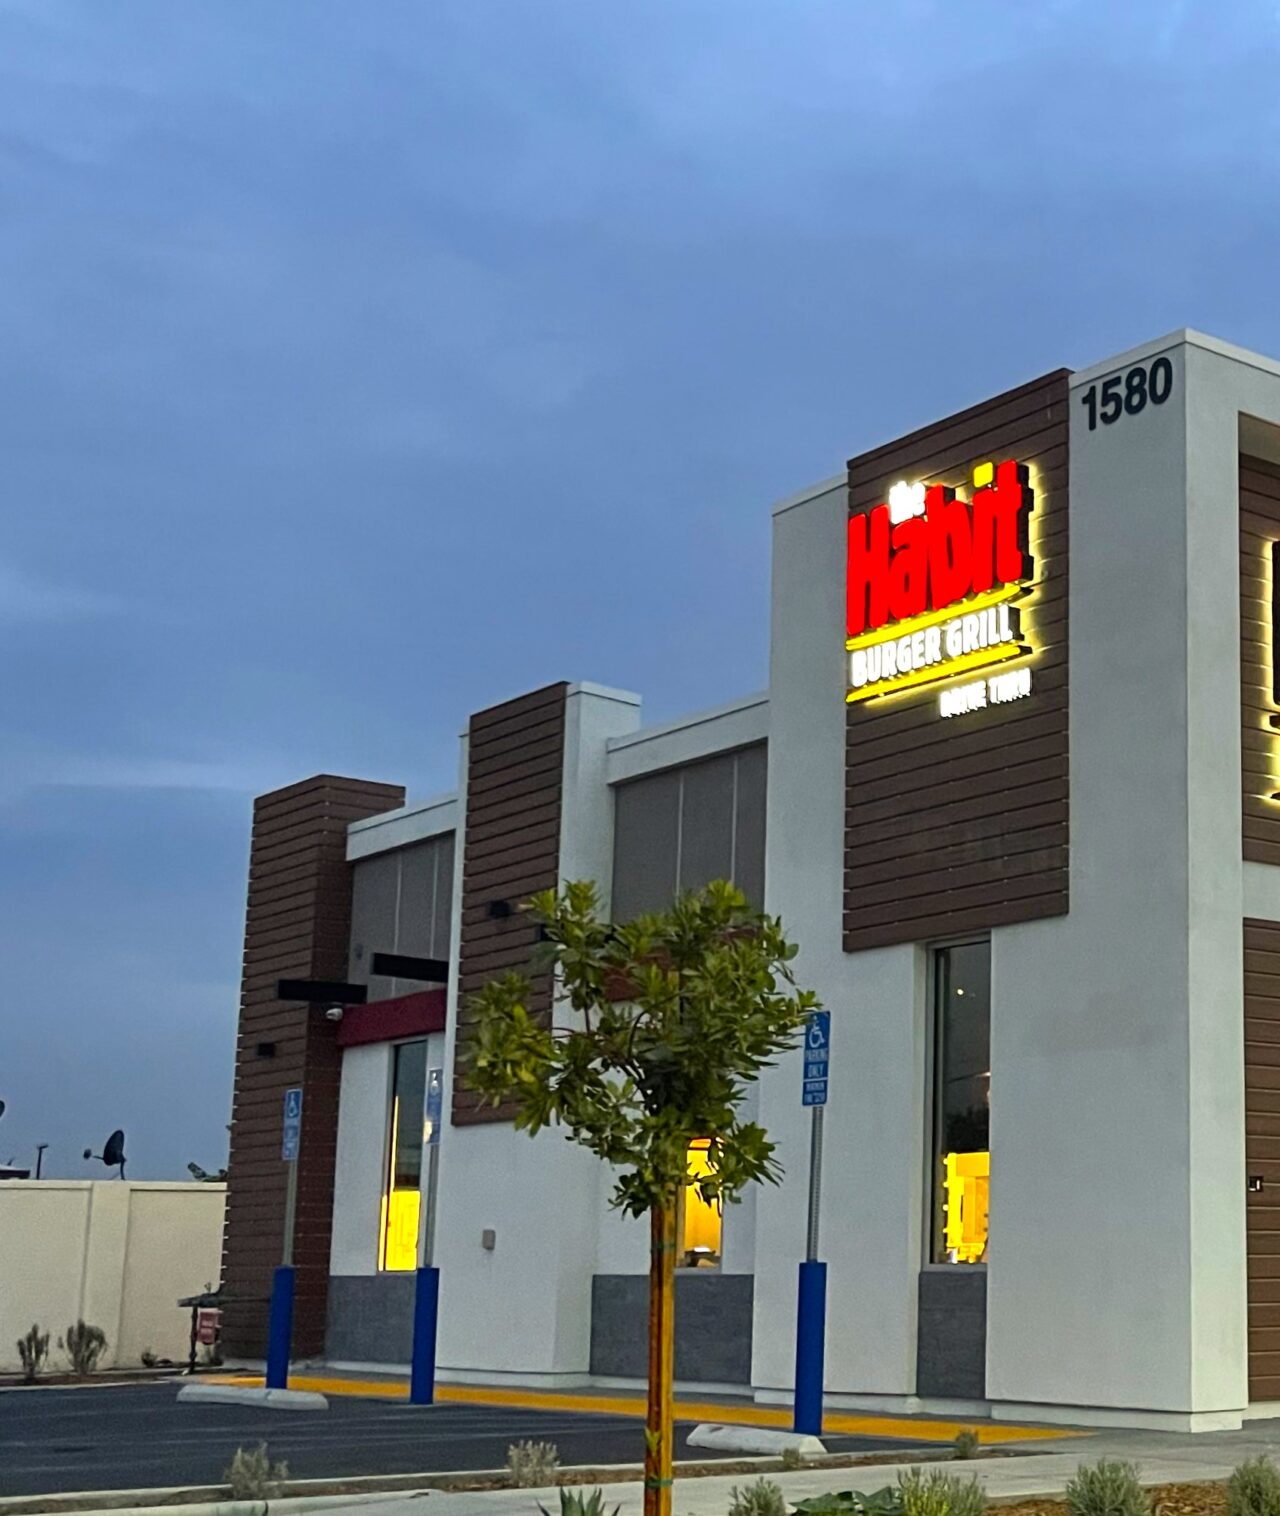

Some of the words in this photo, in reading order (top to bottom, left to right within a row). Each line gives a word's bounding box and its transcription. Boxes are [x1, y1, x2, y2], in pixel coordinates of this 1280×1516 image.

[1081, 356, 1174, 431] 1580
[888, 480, 926, 524] the
[846, 458, 1023, 636] Habit
[850, 629, 942, 688] BURGER
[945, 604, 1014, 658] GRILL
